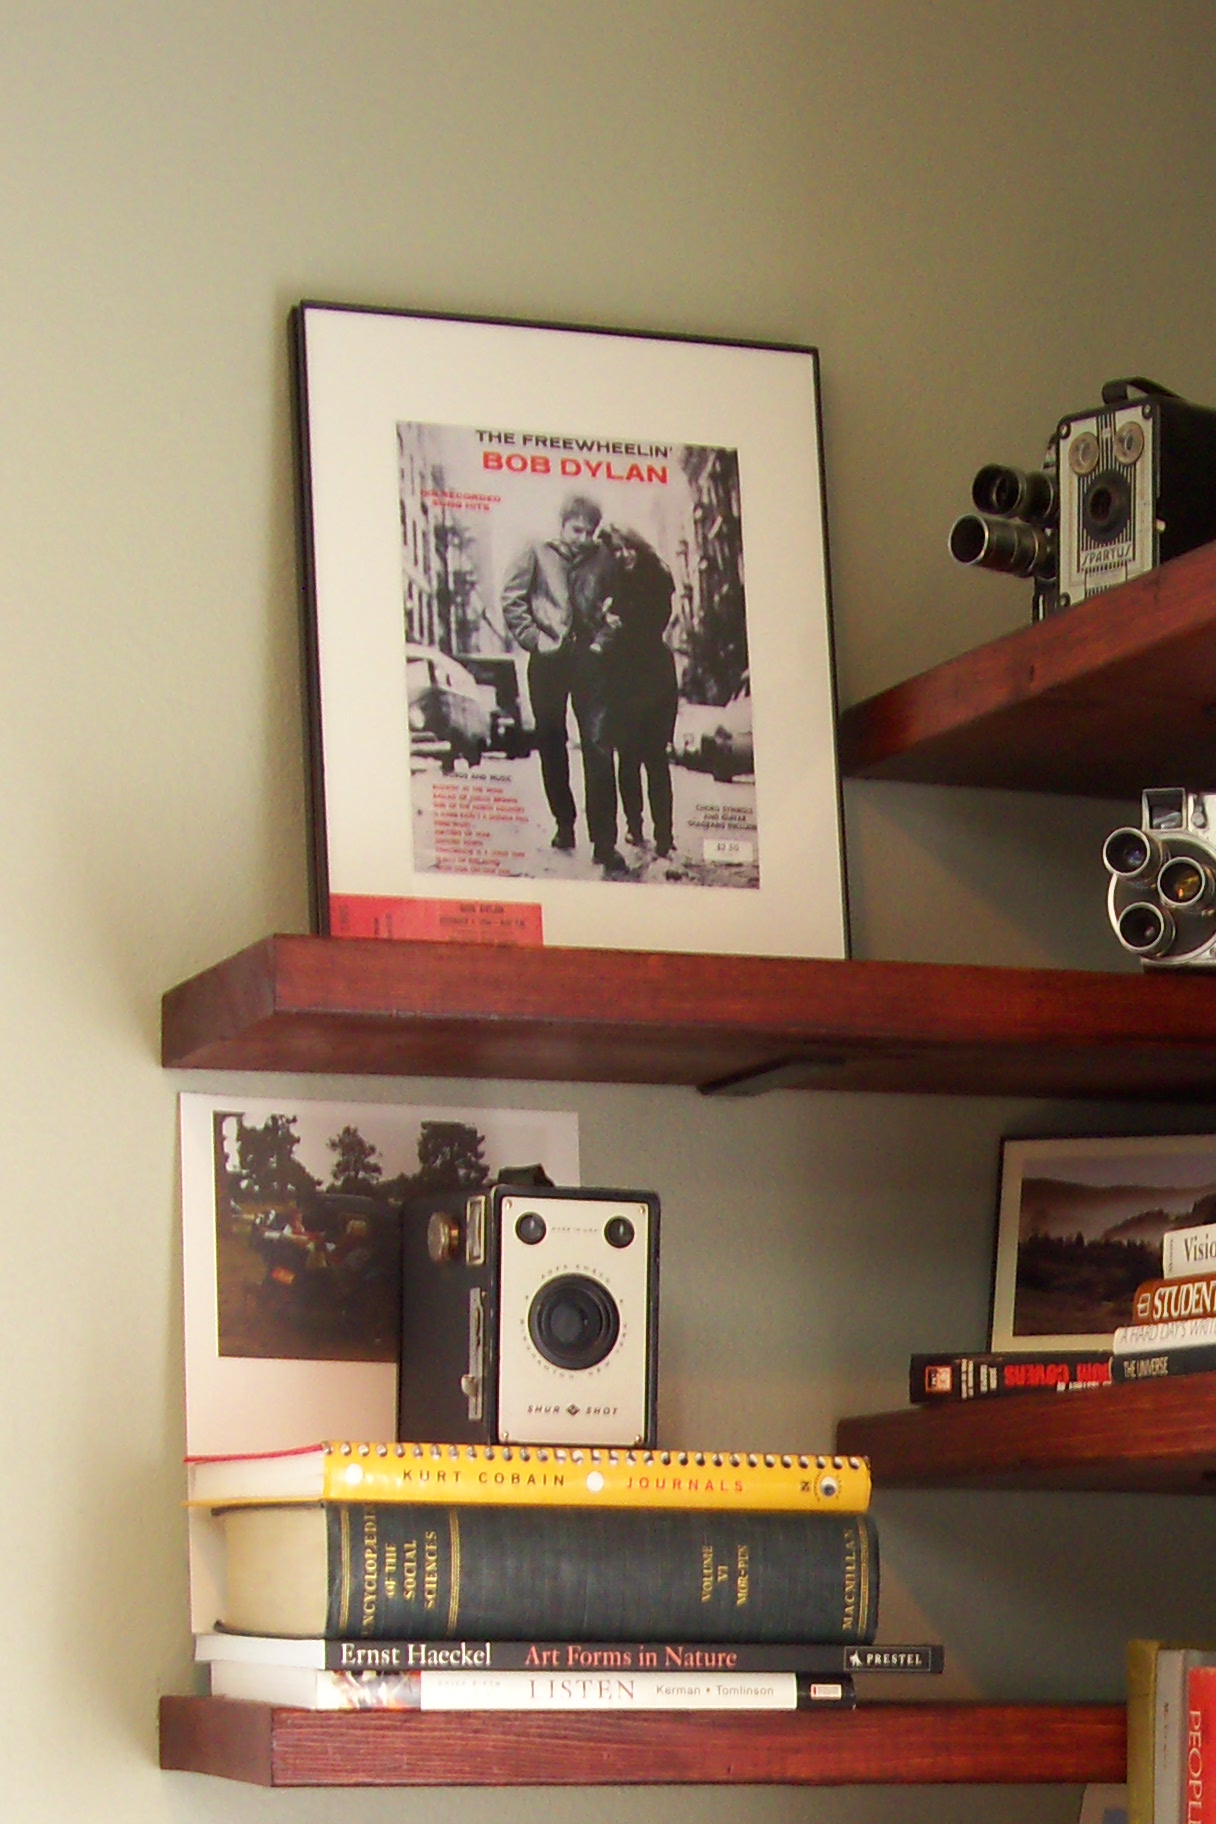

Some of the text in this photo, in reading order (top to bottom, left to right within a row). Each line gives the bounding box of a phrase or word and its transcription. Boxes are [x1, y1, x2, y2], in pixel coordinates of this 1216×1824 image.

[476, 429, 672, 458] THE FREEWHEELIN'
[482, 451, 668, 484] BOB DYLAN
[1081, 543, 1133, 567] SPARTUS
[1121, 1330, 1130, 1344] A
[1130, 1326, 1158, 1343] HARD
[1159, 1322, 1187, 1341] DAY'S
[1123, 1359, 1137, 1379] THE
[1137, 1356, 1169, 1378] UNIVERSE
[527, 1404, 620, 1416] SHUR SHOT
[403, 1469, 744, 1493] KURT COBAIN JOURNALS
[385, 1543, 398, 1599] OF THE
[403, 1539, 418, 1601] SOCIAL
[424, 1530, 438, 1610] SCIENCES
[701, 1544, 714, 1603] VOLUME
[717, 1564, 730, 1583] VI
[842, 1527, 857, 1631] MACMILLAN
[340, 1641, 922, 1668] Ernst Haeckel Art Forms in Nature PRESTEL
[529, 1679, 774, 1700] LISTEN Kerman Tomlinson
